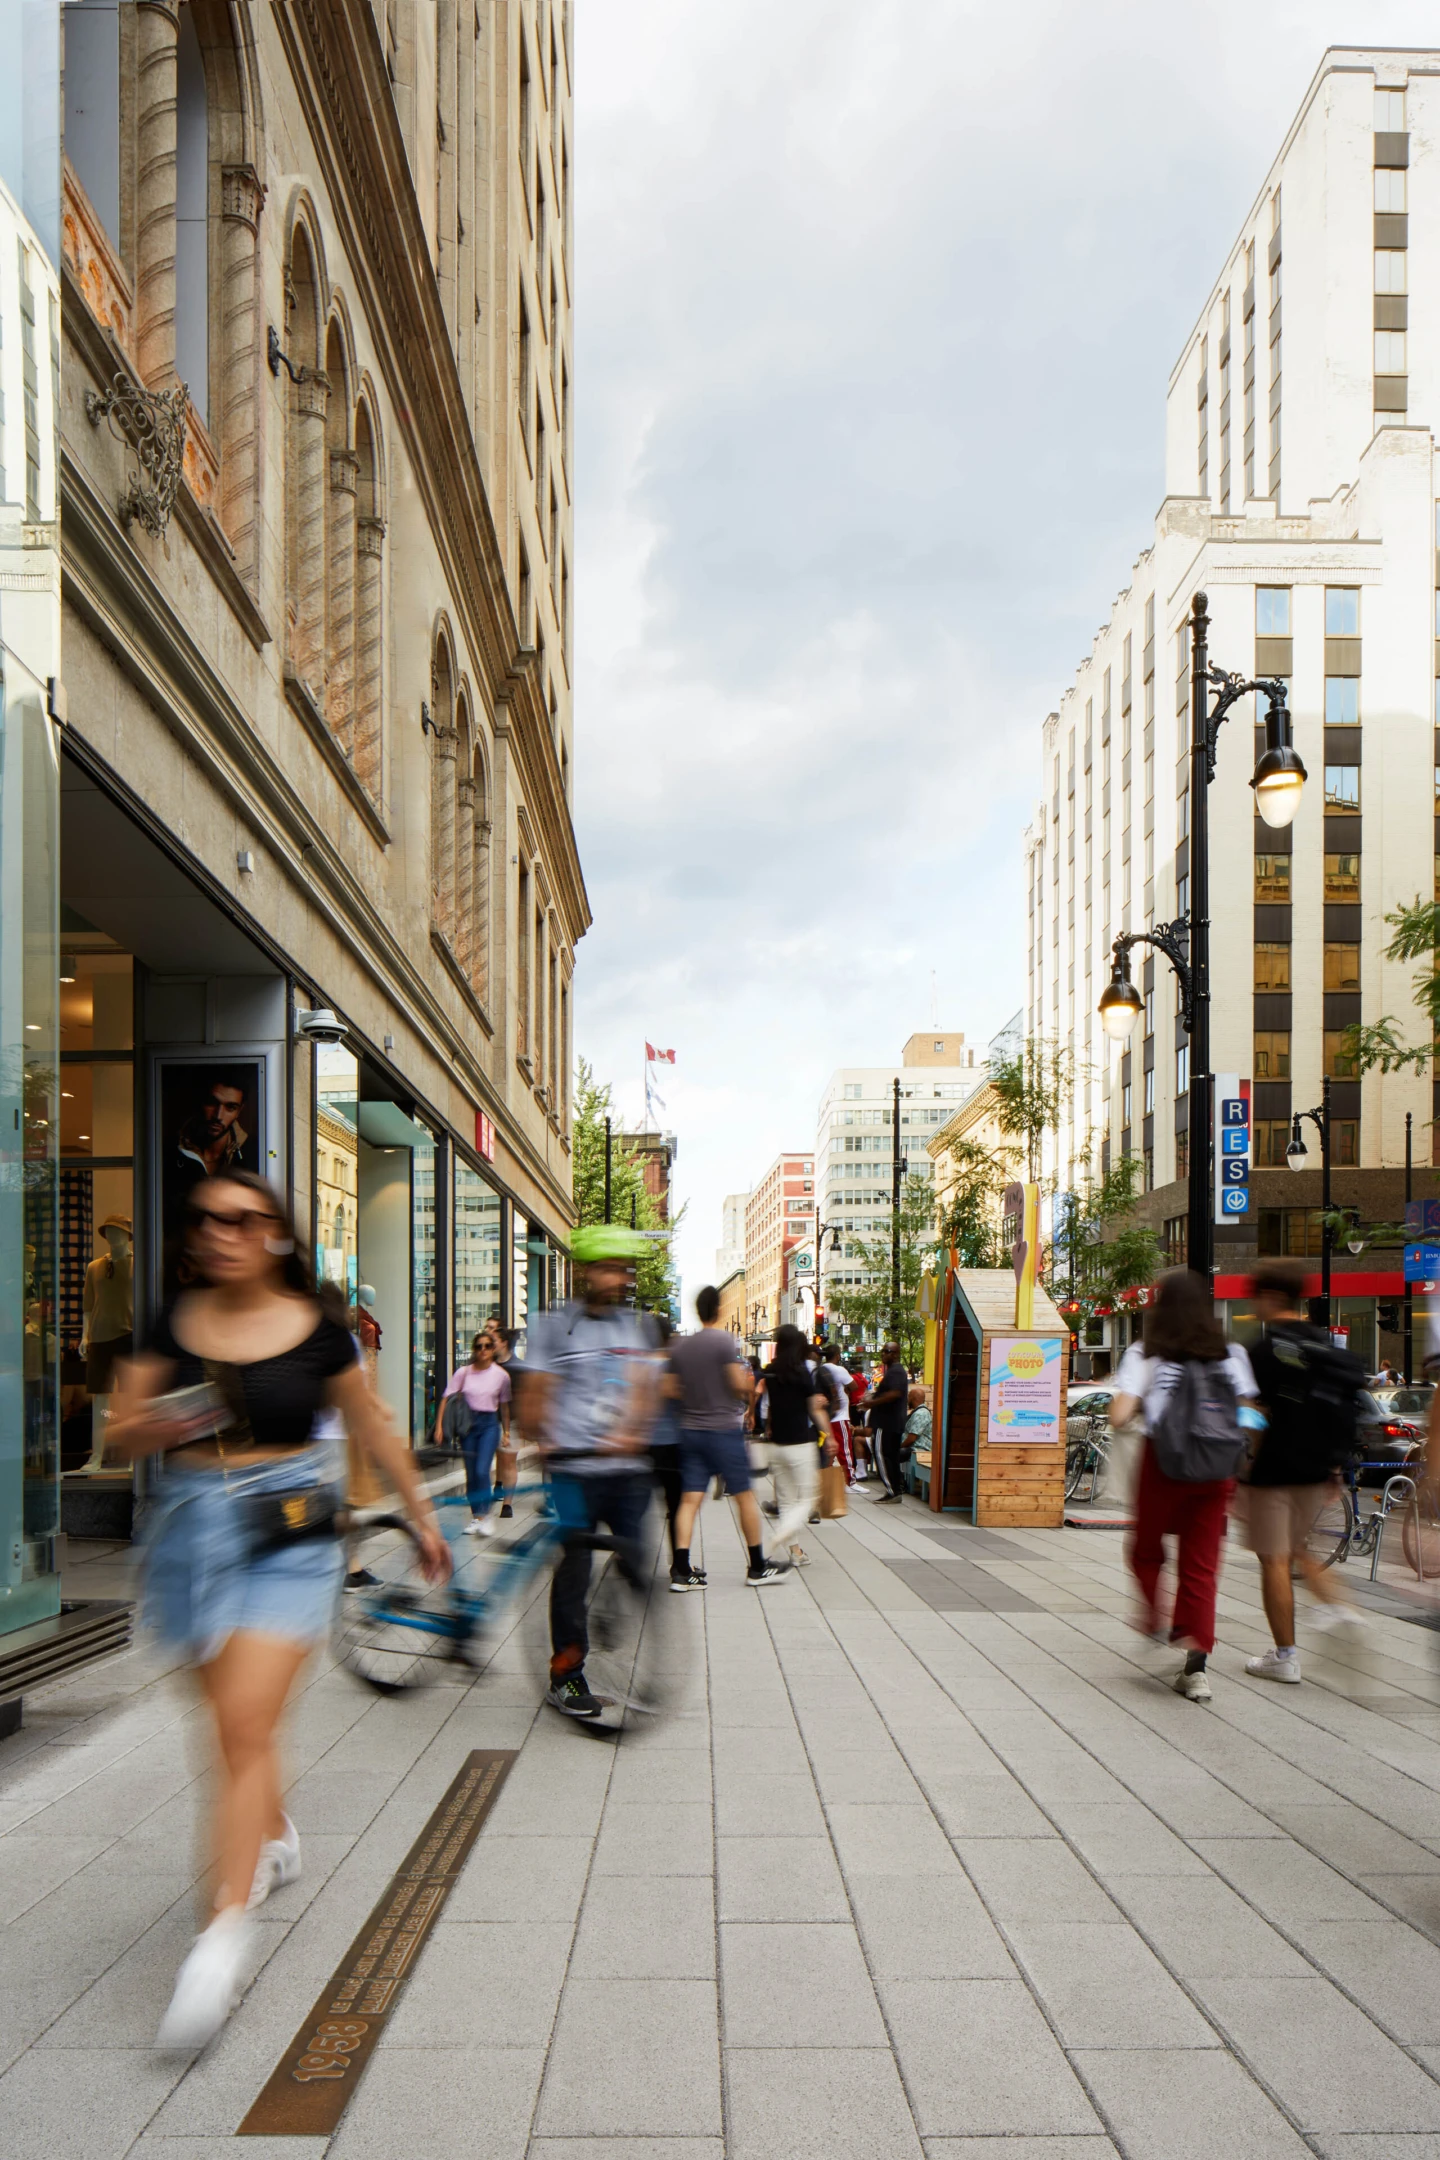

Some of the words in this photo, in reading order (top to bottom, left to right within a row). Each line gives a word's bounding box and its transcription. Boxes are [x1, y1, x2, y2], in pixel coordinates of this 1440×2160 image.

[1008, 1359, 1043, 1369] PHOTO
[402, 1915, 424, 1931] DES
[328, 2001, 352, 2013] LE
[363, 1928, 394, 1954] EATON
[379, 1917, 400, 1928] DE
[293, 2020, 369, 2081] 1958
